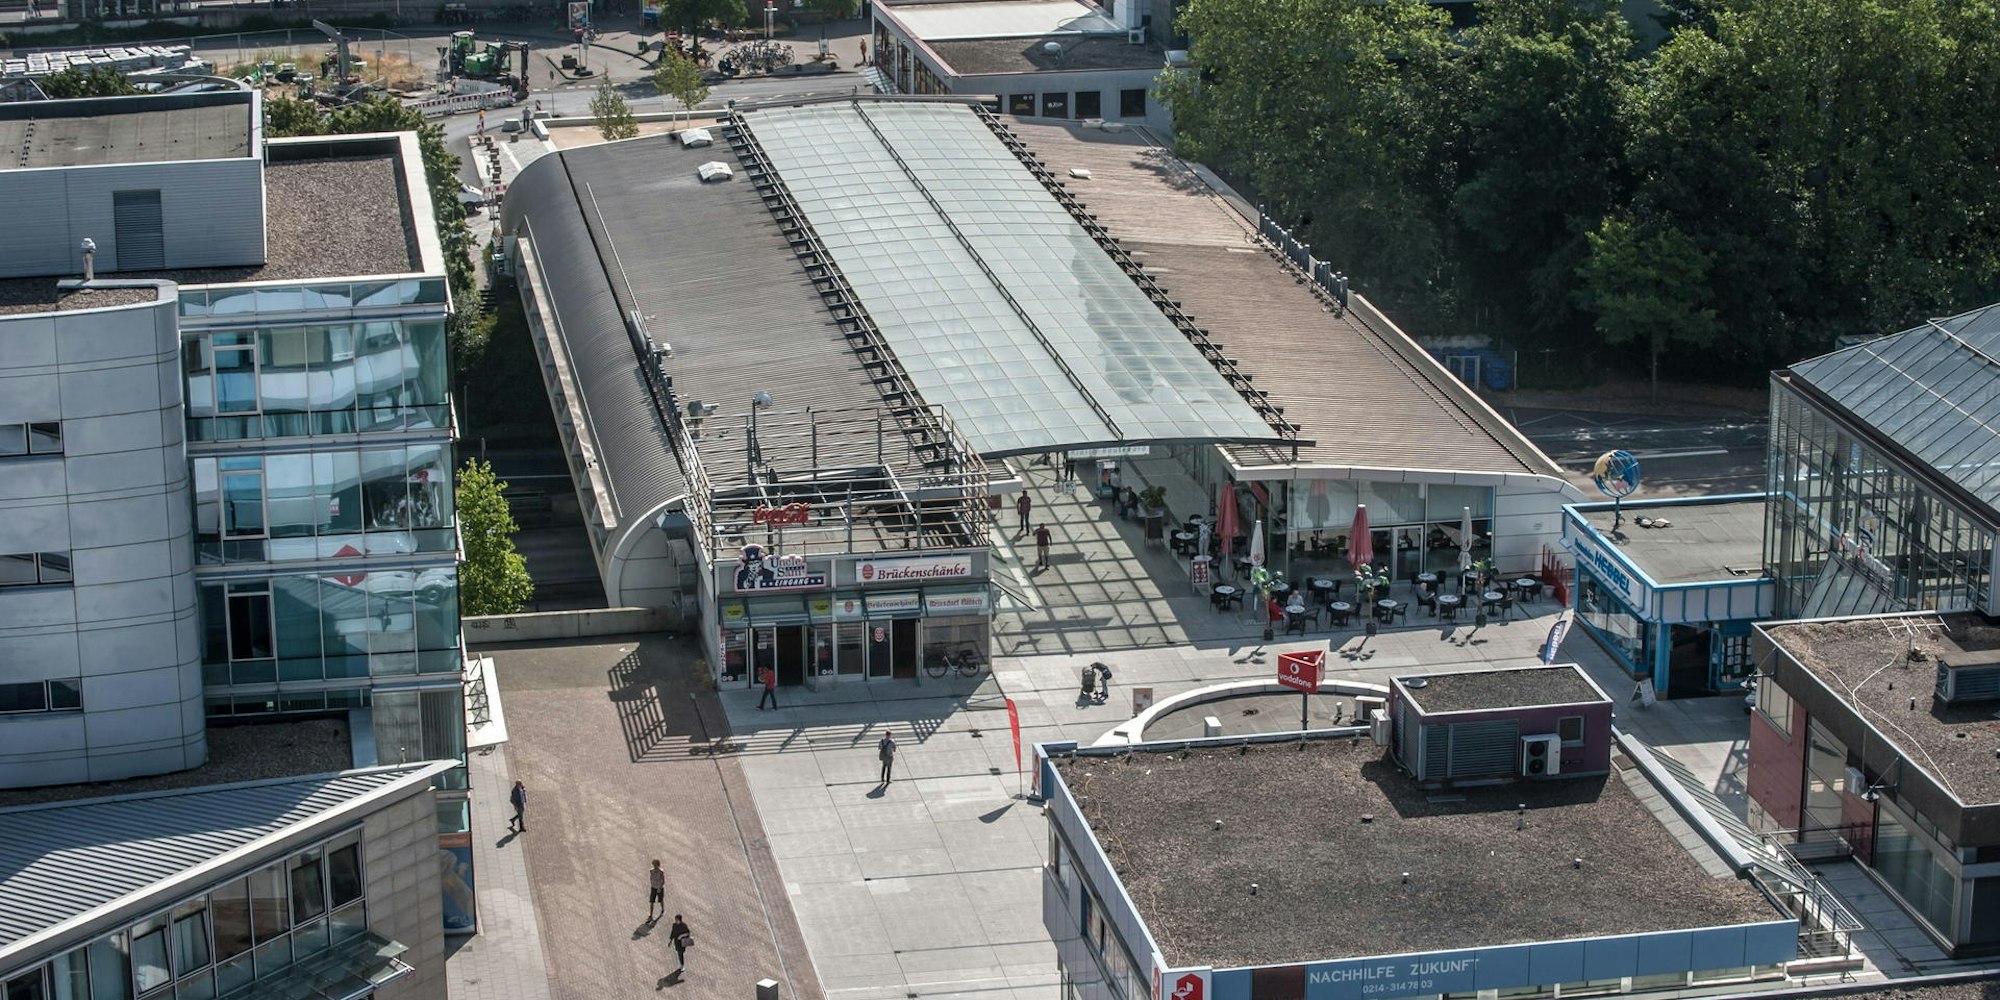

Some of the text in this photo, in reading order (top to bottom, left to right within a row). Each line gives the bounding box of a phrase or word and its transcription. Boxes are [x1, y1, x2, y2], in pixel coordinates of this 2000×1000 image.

[771, 556, 801, 568] Uncle
[877, 563, 966, 580] Brückenschänke
[1594, 550, 1632, 597] HEBBEL
[774, 578, 809, 587] EINGANG
[1279, 673, 1312, 689] vodafone
[1309, 958, 1480, 985] NACHHILFE ZUKUNFT
[1362, 984, 1384, 994] 0214
[1390, 982, 1406, 992] 314
[1407, 981, 1419, 990] 78
[1421, 979, 1433, 989] 03
